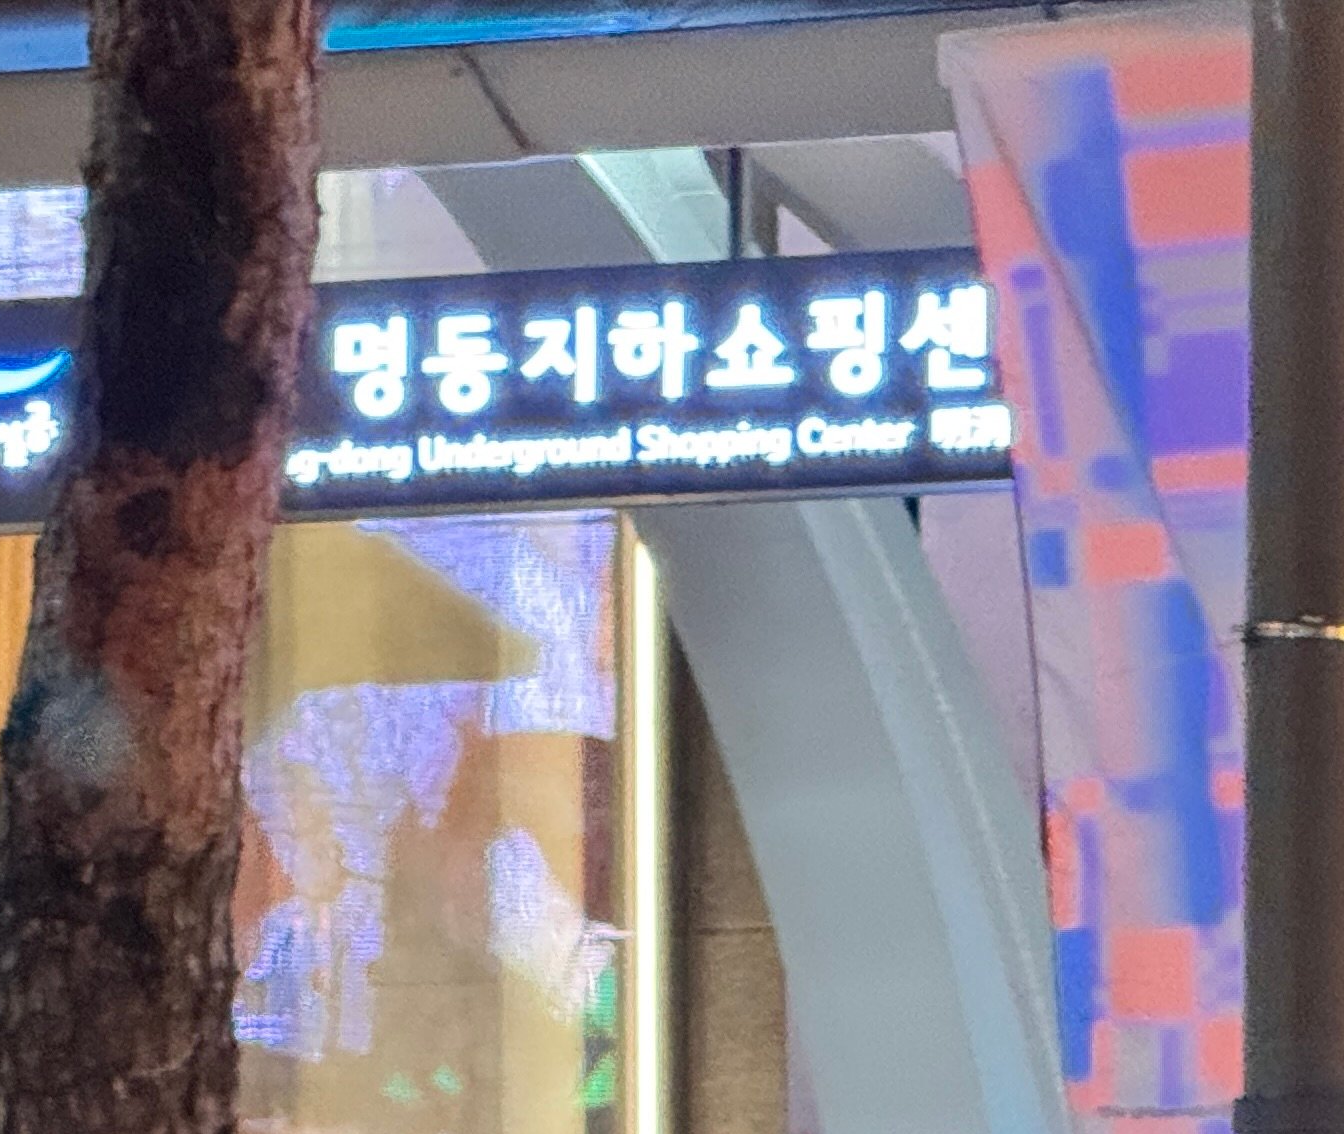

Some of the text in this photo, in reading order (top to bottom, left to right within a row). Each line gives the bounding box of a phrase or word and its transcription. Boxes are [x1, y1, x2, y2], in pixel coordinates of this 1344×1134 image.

[331, 284, 989, 418] 명동지하쇼핑센
[418, 427, 632, 474] Underground
[635, 421, 793, 465] Shopping
[796, 415, 916, 454] Center
